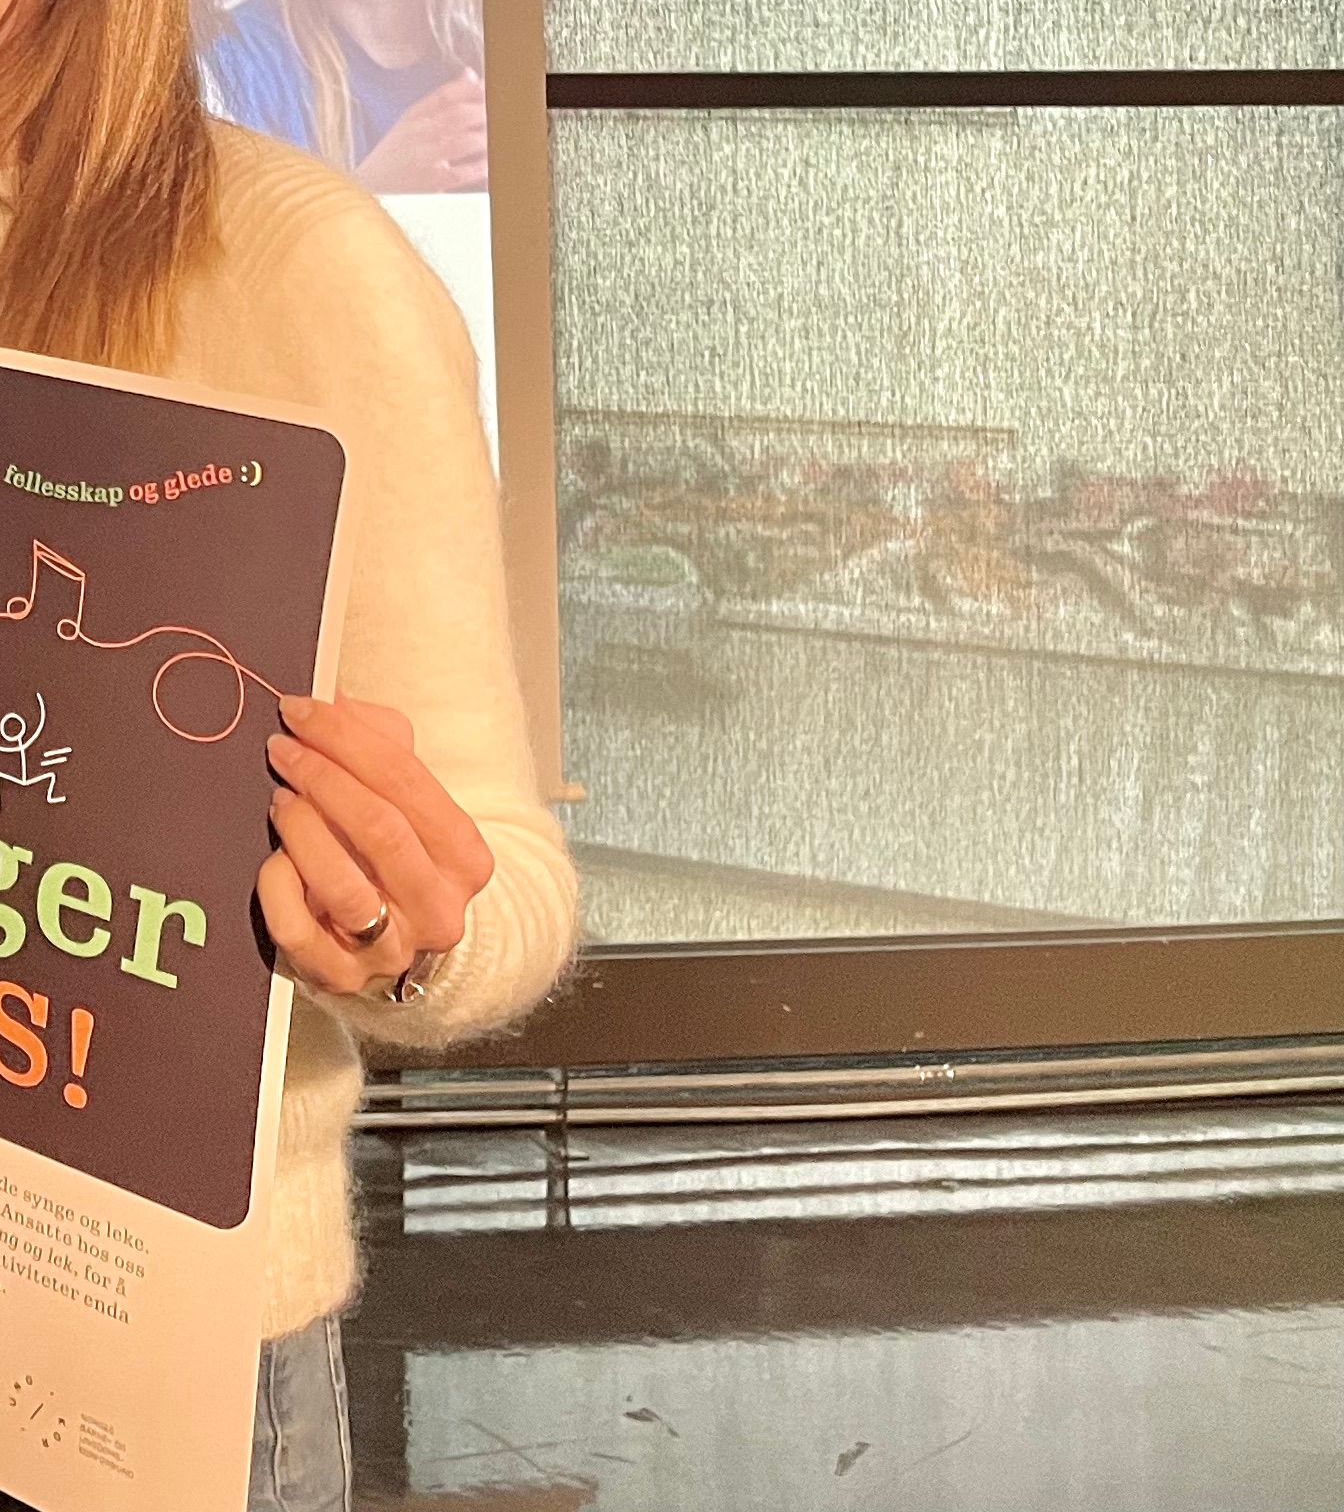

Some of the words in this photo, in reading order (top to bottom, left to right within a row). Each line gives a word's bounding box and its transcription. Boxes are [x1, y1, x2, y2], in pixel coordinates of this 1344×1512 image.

[3, 464, 125, 507] fellesskap
[128, 481, 159, 505] og
[163, 462, 233, 501] glede
[0, 1202, 73, 1246] Ansatte
[77, 1234, 110, 1263] hos
[114, 1253, 146, 1279] oss
[23, 1188, 75, 1222] synge
[79, 1214, 101, 1237] og
[106, 1220, 150, 1255] leke.
[23, 1240, 43, 1262] og
[46, 1247, 79, 1278] lek,
[83, 1264, 112, 1290] for
[115, 1276, 127, 1297] å
[83, 1293, 130, 1324] enda
